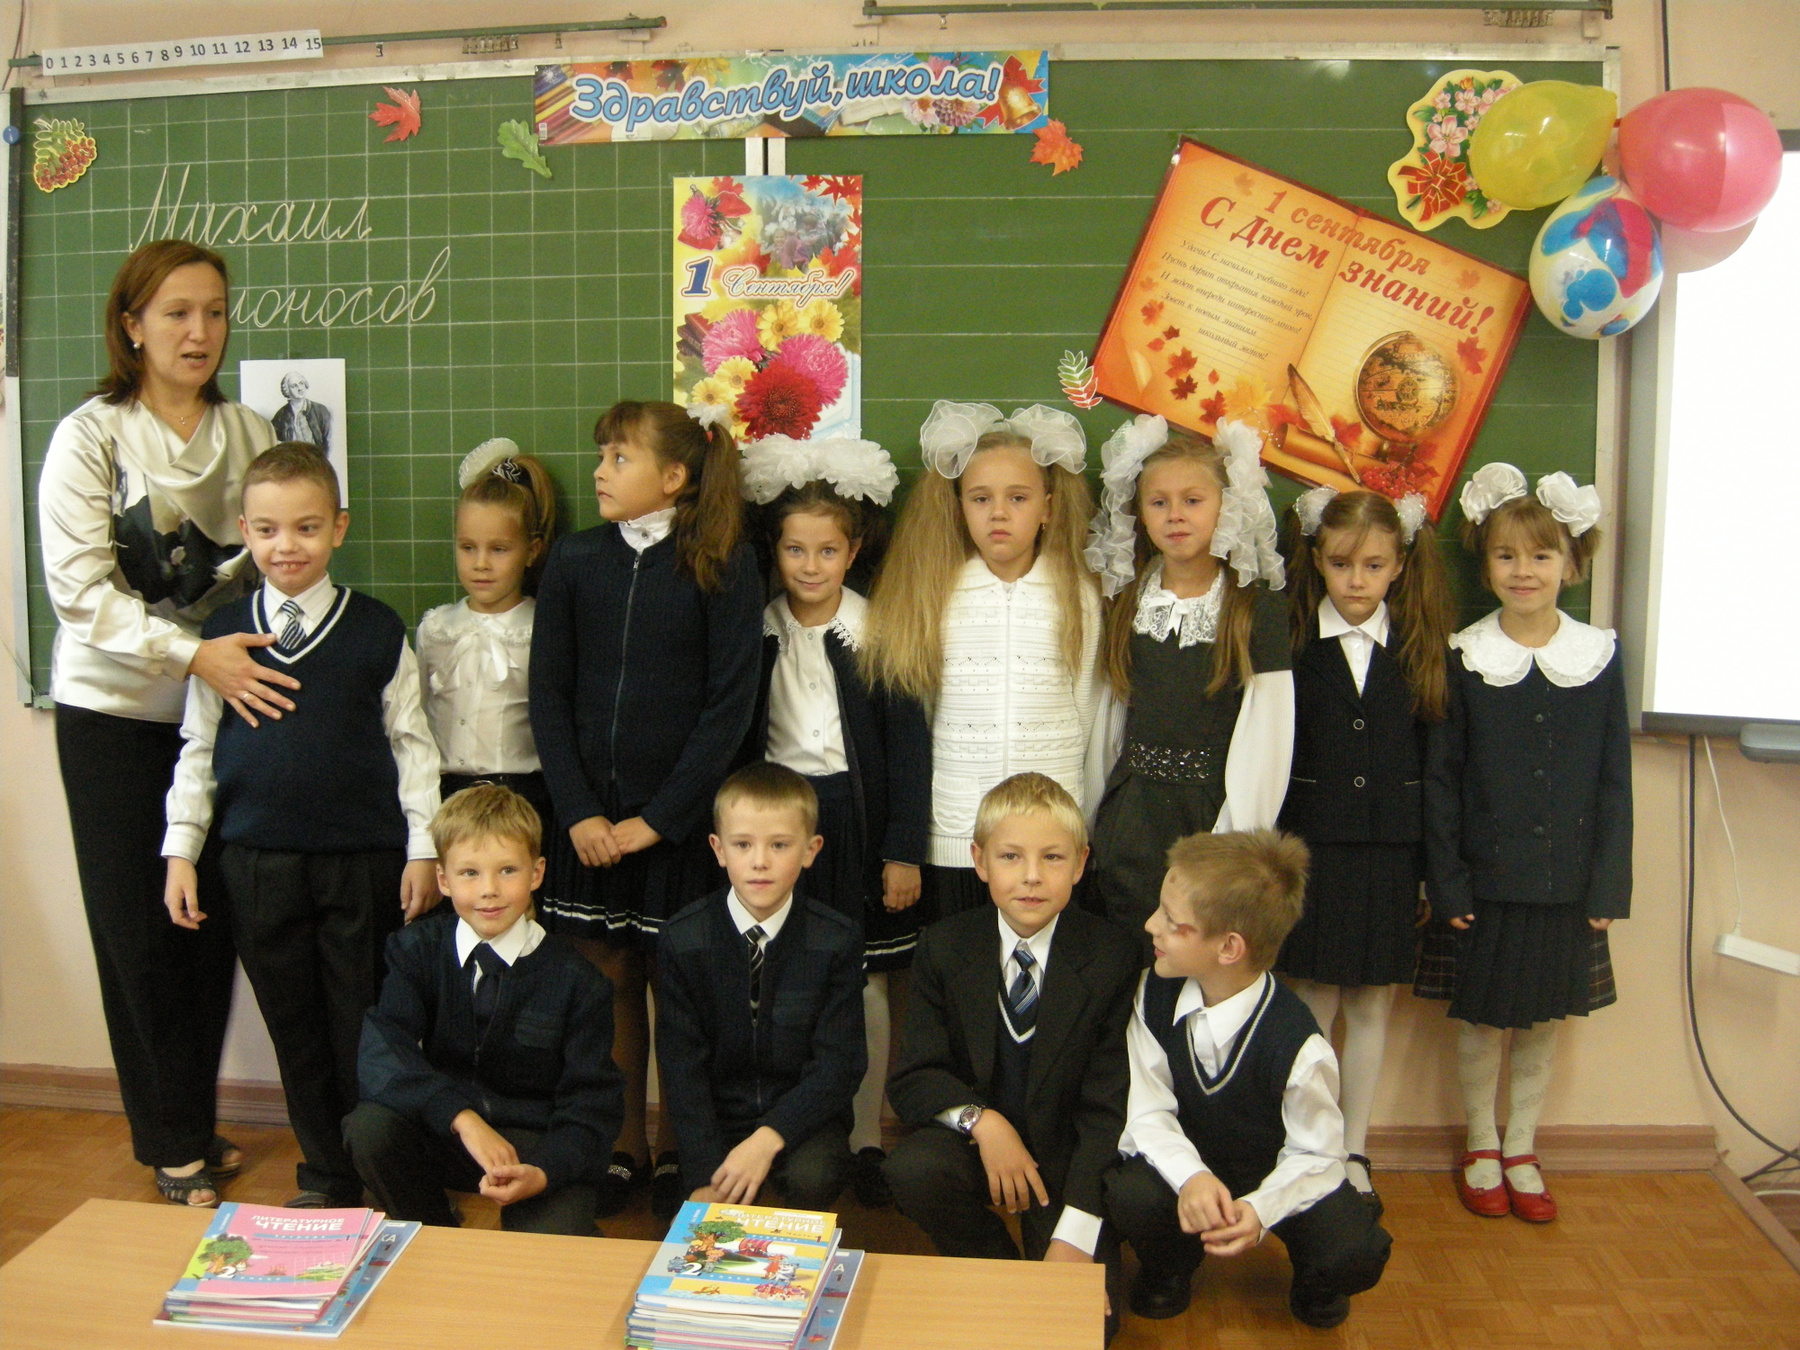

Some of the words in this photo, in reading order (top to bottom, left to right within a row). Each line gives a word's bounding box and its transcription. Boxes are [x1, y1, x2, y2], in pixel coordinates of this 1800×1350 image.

[45, 58, 54, 69] 0
[61, 57, 68, 68] 1
[75, 56, 82, 67] 2
[89, 55, 97, 66] 3
[103, 54, 111, 66] 4
[117, 53, 125, 64] 5
[131, 52, 140, 63] 6
[146, 51, 153, 63] 7
[161, 50, 170, 61] 8
[174, 46, 183, 58] 9
[190, 44, 206, 56] 10
[212, 42, 228, 55] 11
[234, 41, 251, 53] 12
[258, 39, 274, 51] 13
[281, 37, 298, 50] 14
[305, 38, 321, 50] 15
[572, 64, 842, 132] Здравствуй,
[846, 67, 1000, 102] школа!
[129, 164, 373, 252] Михаил
[1263, 190, 1287, 214] 1
[1291, 207, 1431, 276] сентября
[683, 257, 713, 296] 1
[724, 269, 853, 306] Сентября!
[1161, 251, 1187, 268] Пусть
[1190, 264, 1215, 279] дарит
[1217, 276, 1259, 297] открытия
[1261, 294, 1293, 312] каждый
[1180, 240, 1210, 257] Удачи!
[1211, 252, 1219, 261] С
[1220, 259, 1254, 276] началом
[1254, 273, 1288, 290] учебного
[1289, 287, 1309, 298] года!
[1200, 196, 1237, 229] С
[1230, 215, 1331, 270] Днем
[1338, 260, 1495, 335] знаний!
[1160, 271, 1171, 280] И
[1171, 278, 1194, 290] ждет
[1196, 288, 1226, 303] впереди
[1227, 300, 1274, 323] интересного
[1275, 321, 1303, 334] много!
[1195, 306, 1220, 321] новым
[1221, 318, 1257, 336] знаниям
[1198, 327, 1238, 348] школьный
[1239, 344, 1269, 360] звонок!
[251, 1215, 345, 1224] ЛИТЕРАТУРНОЕ
[255, 1220, 343, 1231] ЧТЕНИЕ
[737, 1218, 825, 1234] ЧТЕНИЕ
[815, 1235, 822, 1243] 1
[217, 1266, 237, 1279] 2
[680, 1262, 703, 1276] 2
